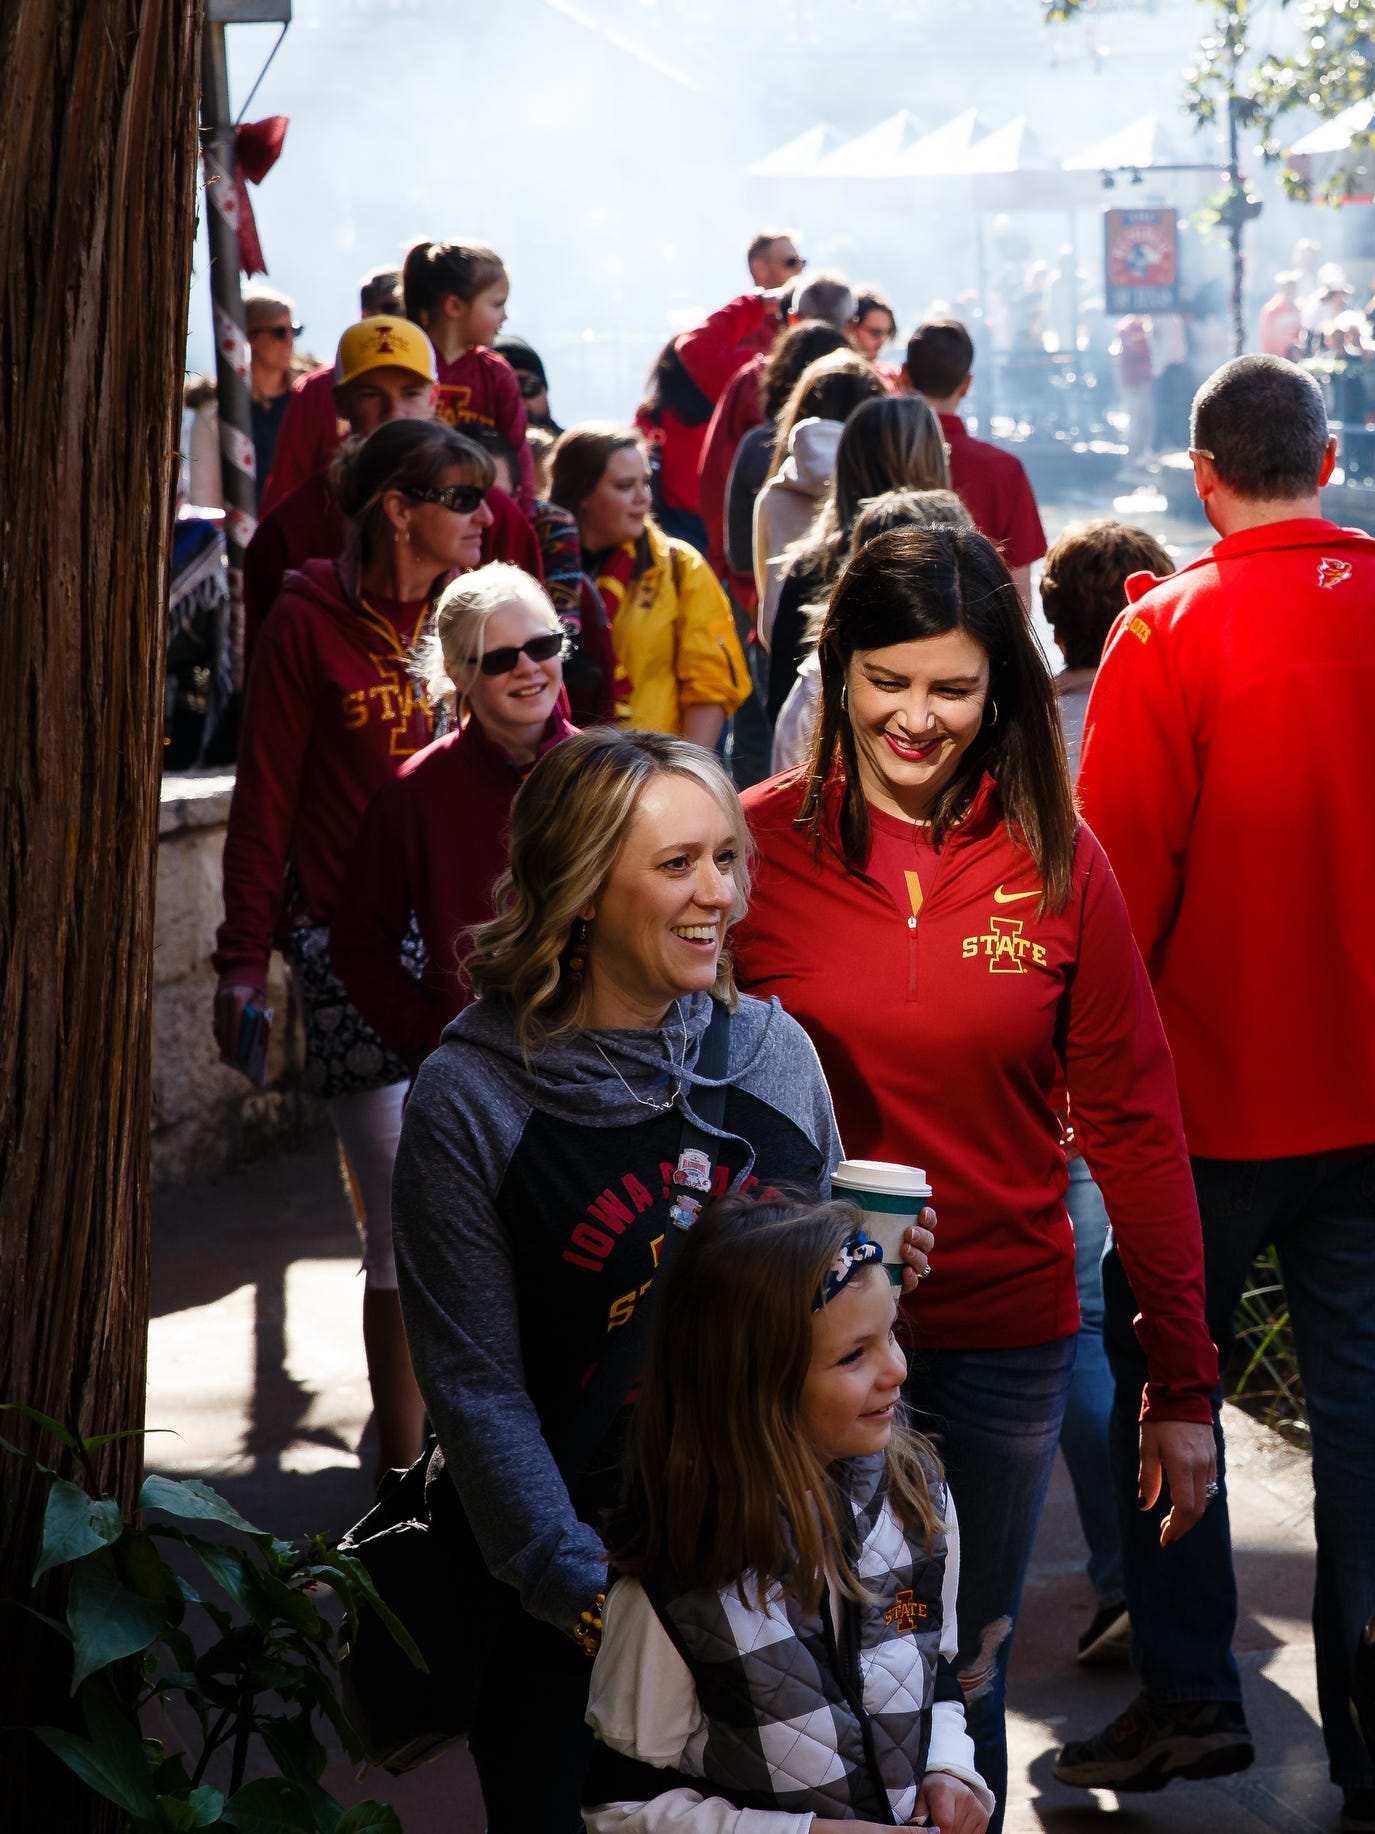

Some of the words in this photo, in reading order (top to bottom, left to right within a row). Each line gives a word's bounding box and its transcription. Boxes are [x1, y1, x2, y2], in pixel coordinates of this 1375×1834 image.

[342, 685, 436, 729] STA
[961, 934, 1048, 967] STATE
[562, 1172, 655, 1273] IOWA
[883, 1601, 929, 1627] STATE
